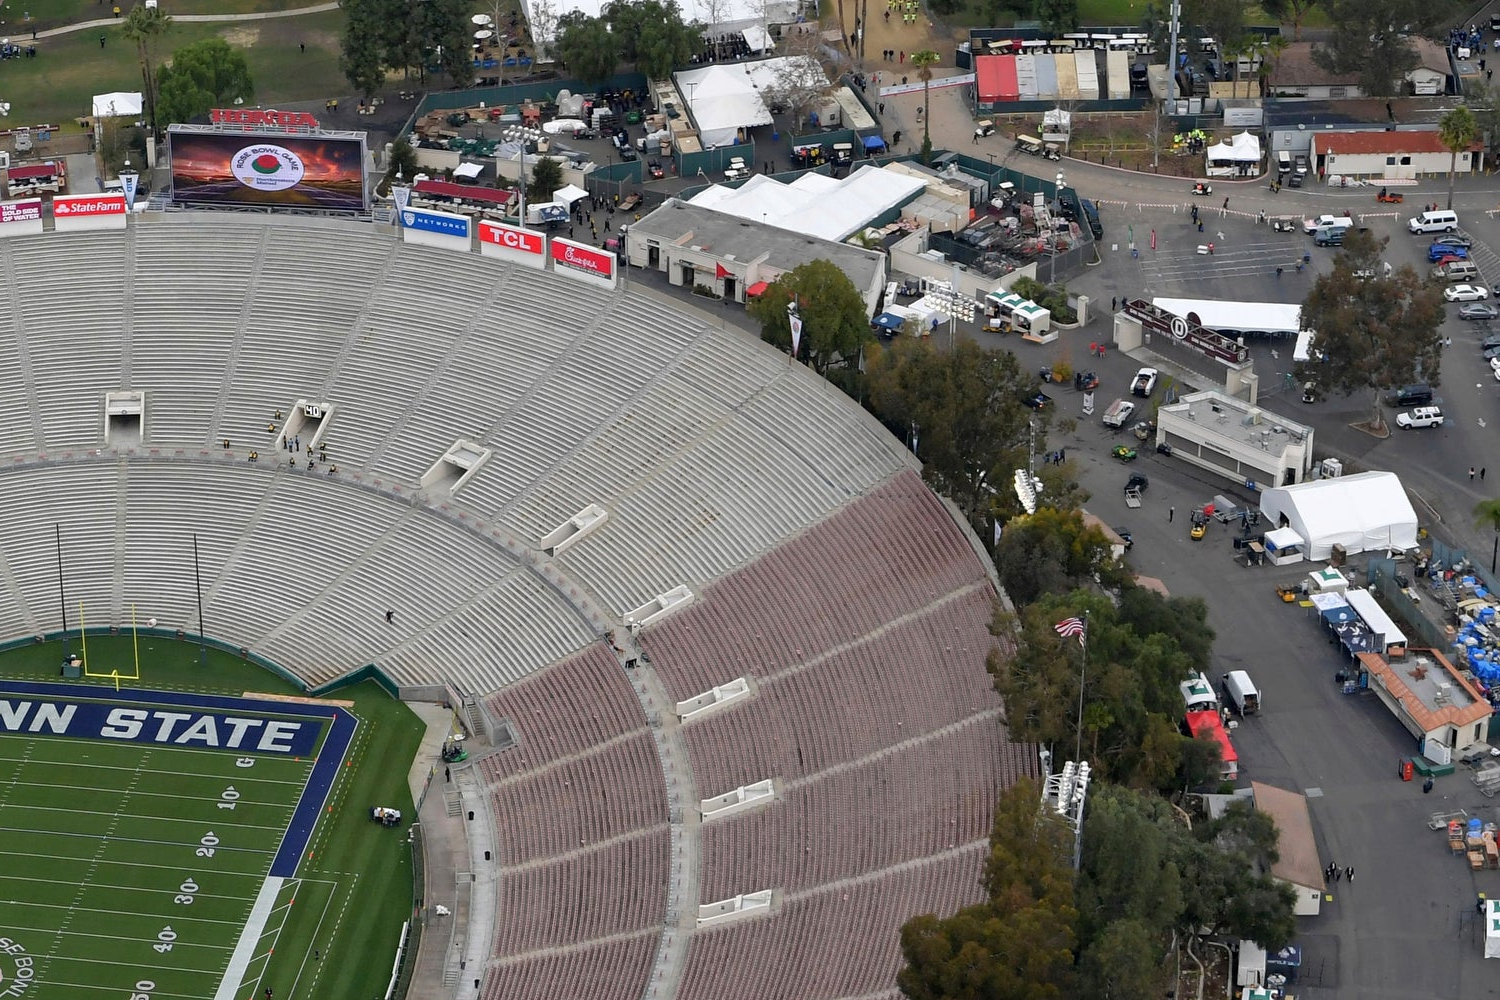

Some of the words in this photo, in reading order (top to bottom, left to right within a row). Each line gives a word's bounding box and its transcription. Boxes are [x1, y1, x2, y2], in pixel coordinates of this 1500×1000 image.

[211, 109, 319, 127] HONDA
[237, 152, 251, 168] ROSE
[282, 153, 298, 170] GAME
[13, 213, 39, 221] WATER
[417, 218, 466, 230] NETWORKS
[489, 228, 531, 250] TCL
[1175, 320, 1184, 335] D
[306, 405, 319, 416] 40
[100, 708, 302, 752] STATE
[236, 757, 255, 768] G
[217, 789, 240, 810] 10
[195, 835, 219, 858] 20
[174, 882, 199, 905] 30
[152, 930, 177, 953] 40
